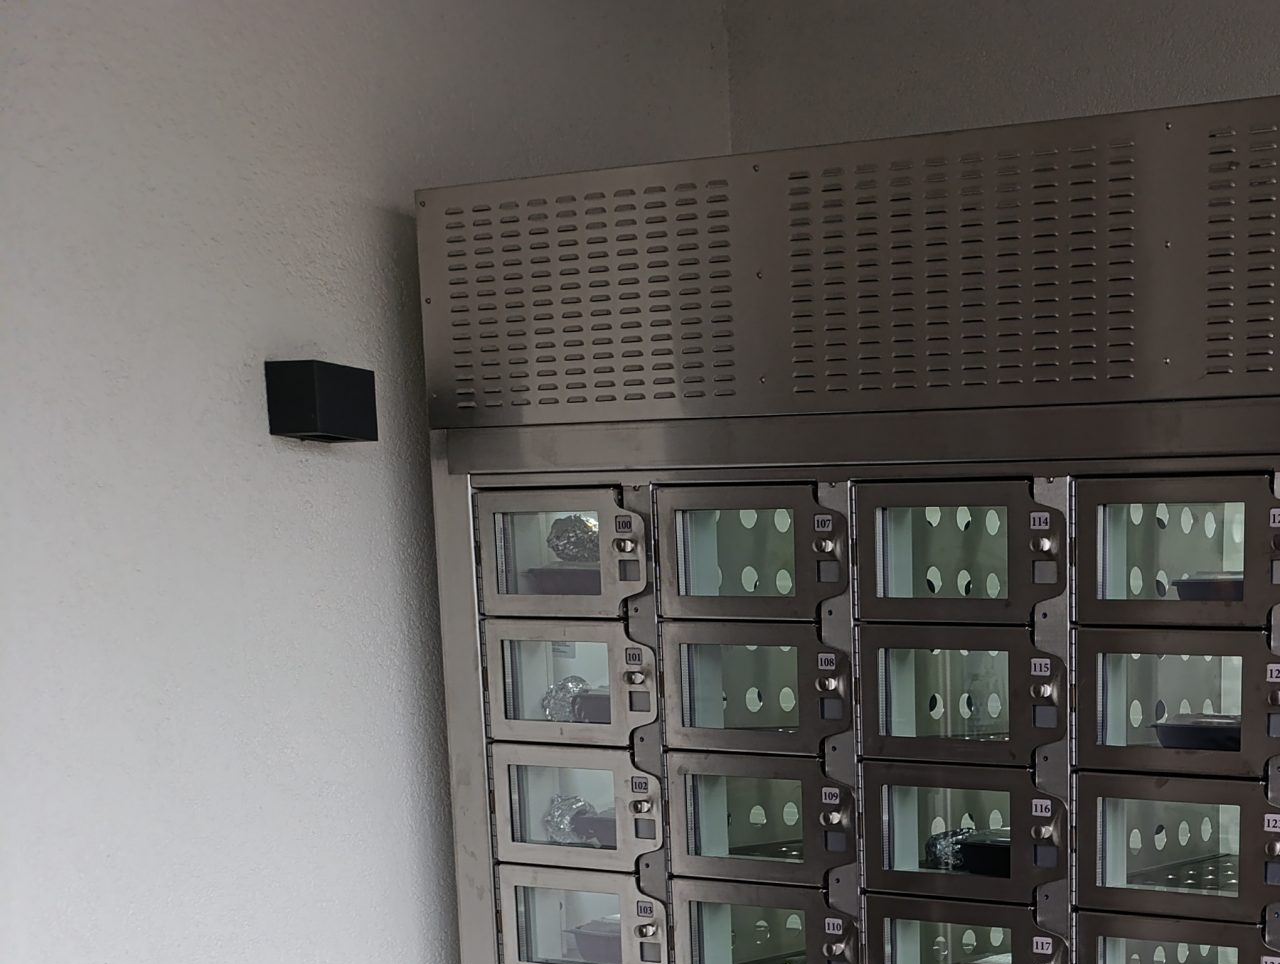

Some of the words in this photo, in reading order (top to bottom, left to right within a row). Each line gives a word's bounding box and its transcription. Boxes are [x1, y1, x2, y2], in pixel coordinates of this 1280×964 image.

[617, 521, 632, 530] 100
[816, 519, 831, 528] 107
[1032, 516, 1049, 526] 114
[628, 653, 641, 662] 101
[820, 657, 835, 667] 108
[1032, 662, 1050, 672] 115
[634, 781, 648, 790] 102
[823, 792, 838, 801] 109
[1034, 803, 1050, 814] 116
[639, 906, 652, 915] 103
[826, 922, 842, 932] 110
[1034, 941, 1052, 951] 117
